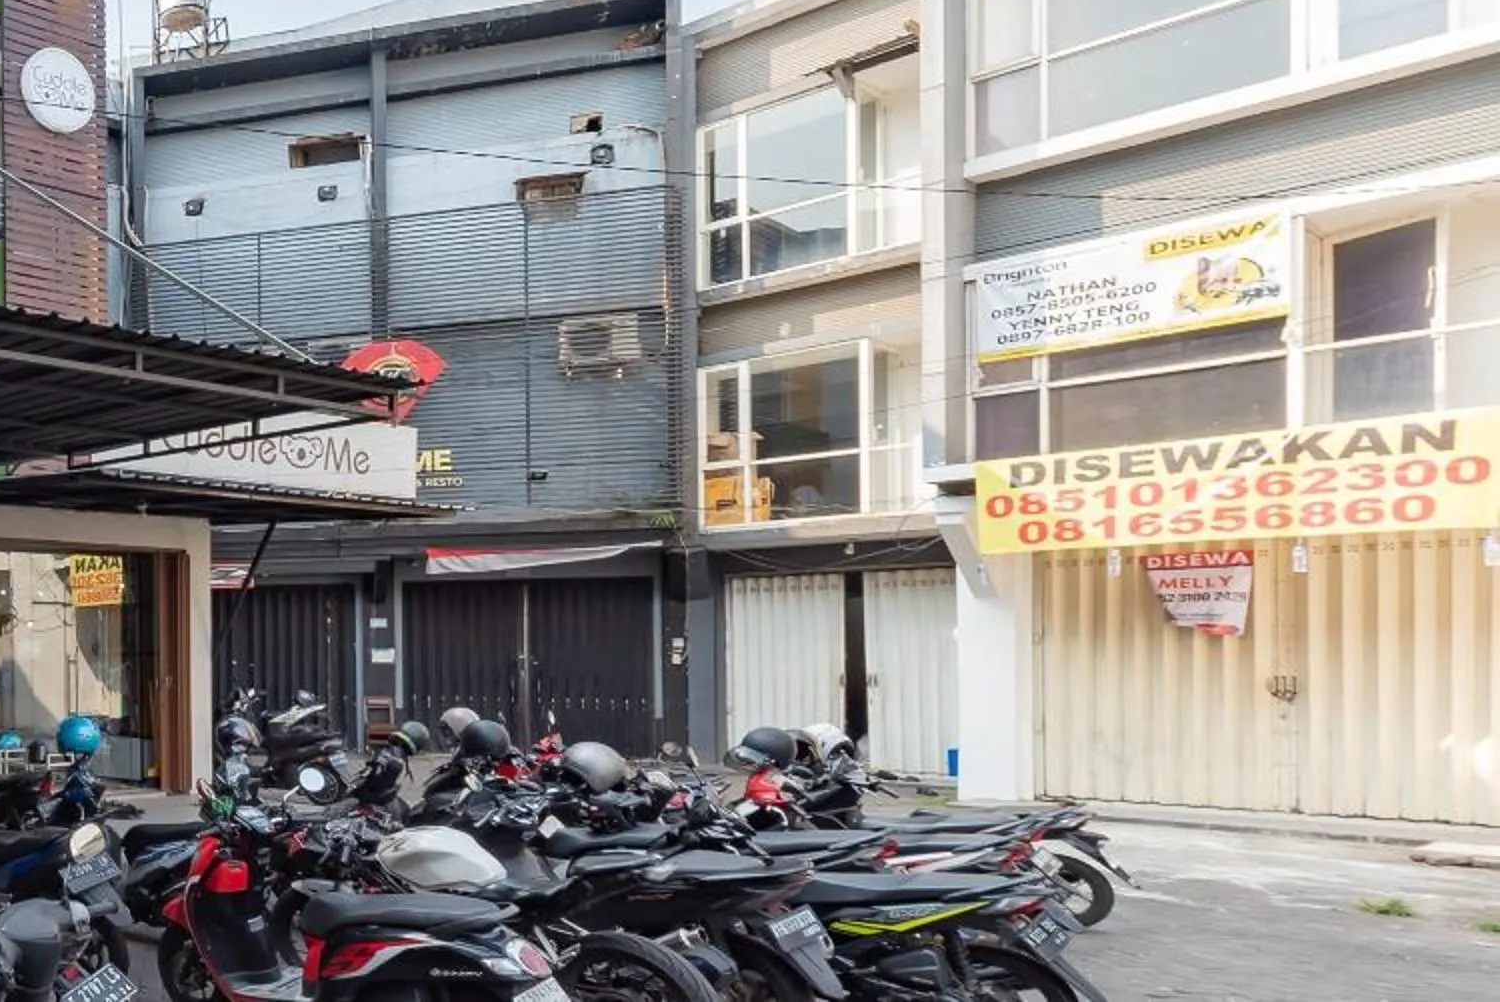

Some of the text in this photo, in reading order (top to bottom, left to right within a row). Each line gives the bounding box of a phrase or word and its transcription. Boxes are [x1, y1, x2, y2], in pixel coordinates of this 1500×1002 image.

[1148, 221, 1266, 255] DISEWA
[1027, 276, 1117, 303] NATHAN
[1009, 301, 1140, 331] YENNY TENG
[324, 436, 370, 474] Me
[1010, 419, 1457, 488] DISEWAKAN
[425, 477, 463, 487] RESTO
[985, 455, 1491, 518] 085101362300
[1017, 494, 1436, 545] 0816556860
[1146, 551, 1250, 569] DISEWA
[1158, 575, 1234, 590] MELLY
